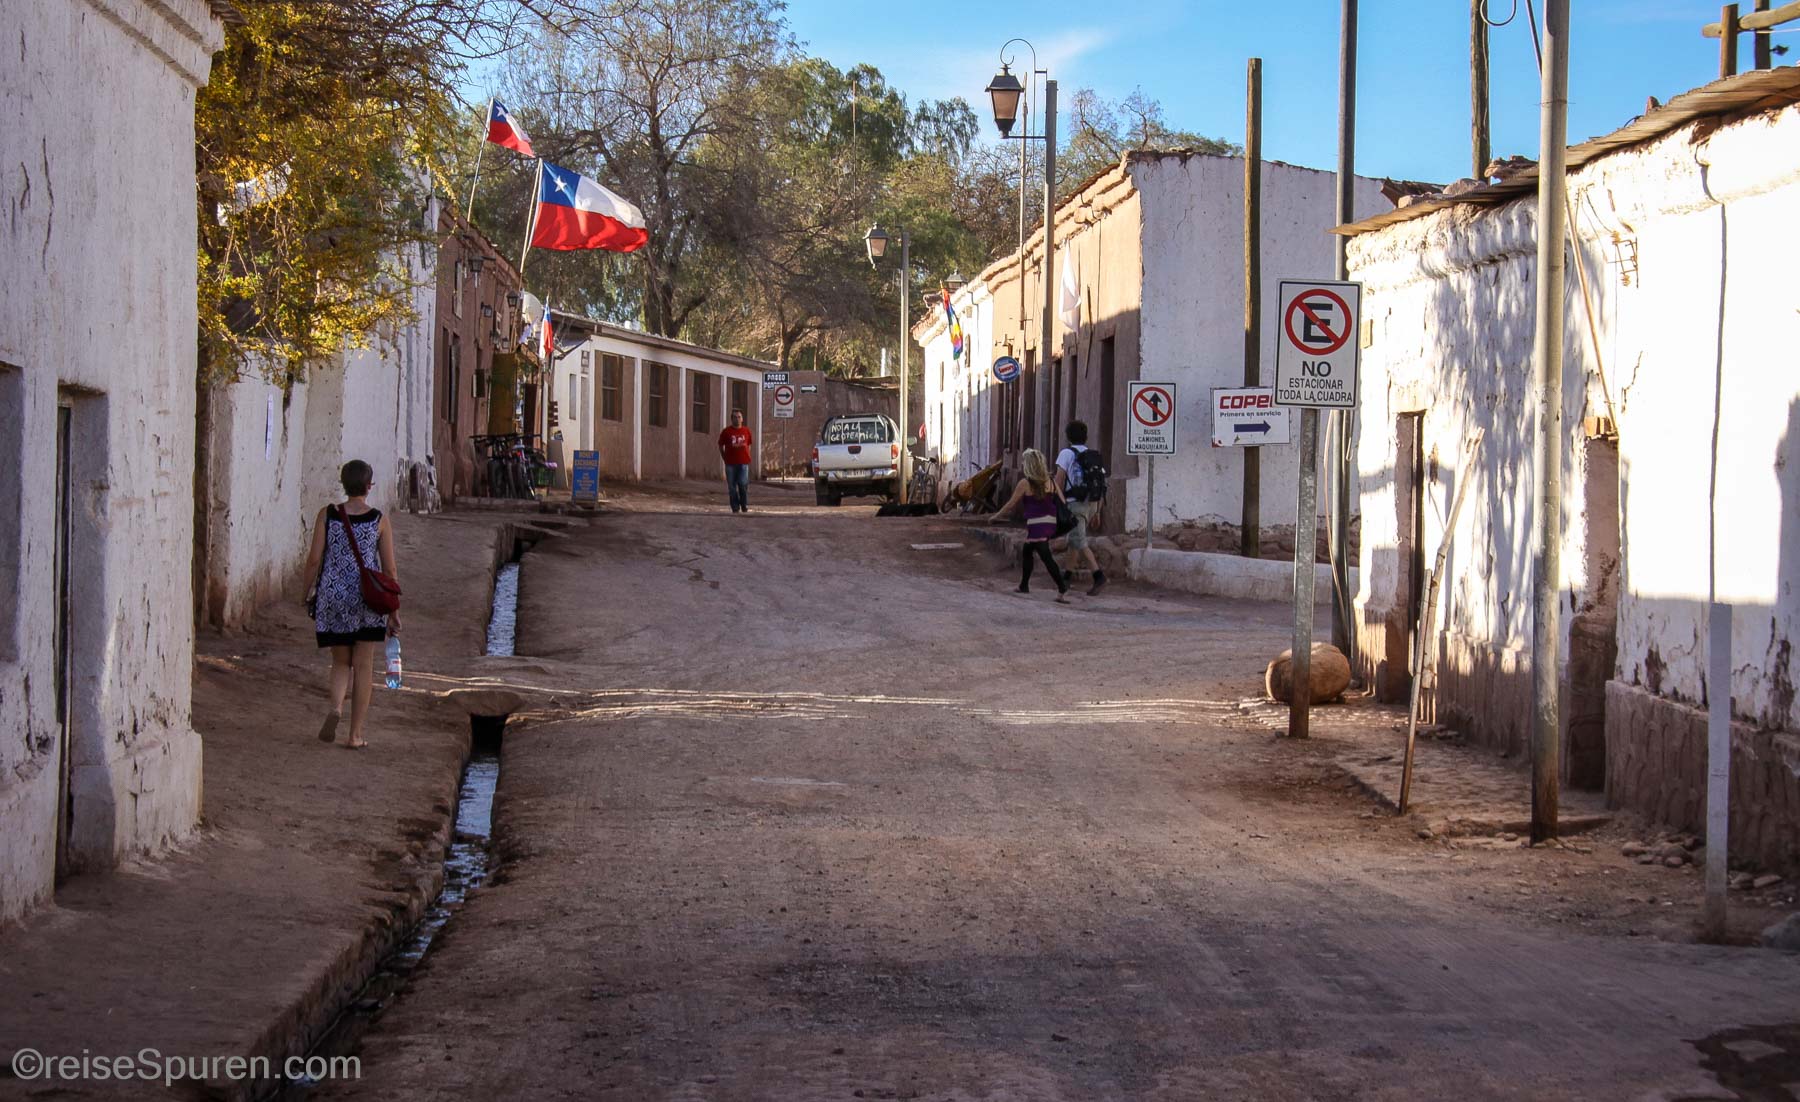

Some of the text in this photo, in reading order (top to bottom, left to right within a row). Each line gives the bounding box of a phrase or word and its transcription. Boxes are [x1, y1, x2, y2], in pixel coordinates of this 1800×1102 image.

[1302, 361, 1332, 377] NO
[1289, 378, 1343, 390] ESTACIONAR
[1279, 389, 1353, 402] TODA LA CUADRA
[831, 424, 842, 433] NO
